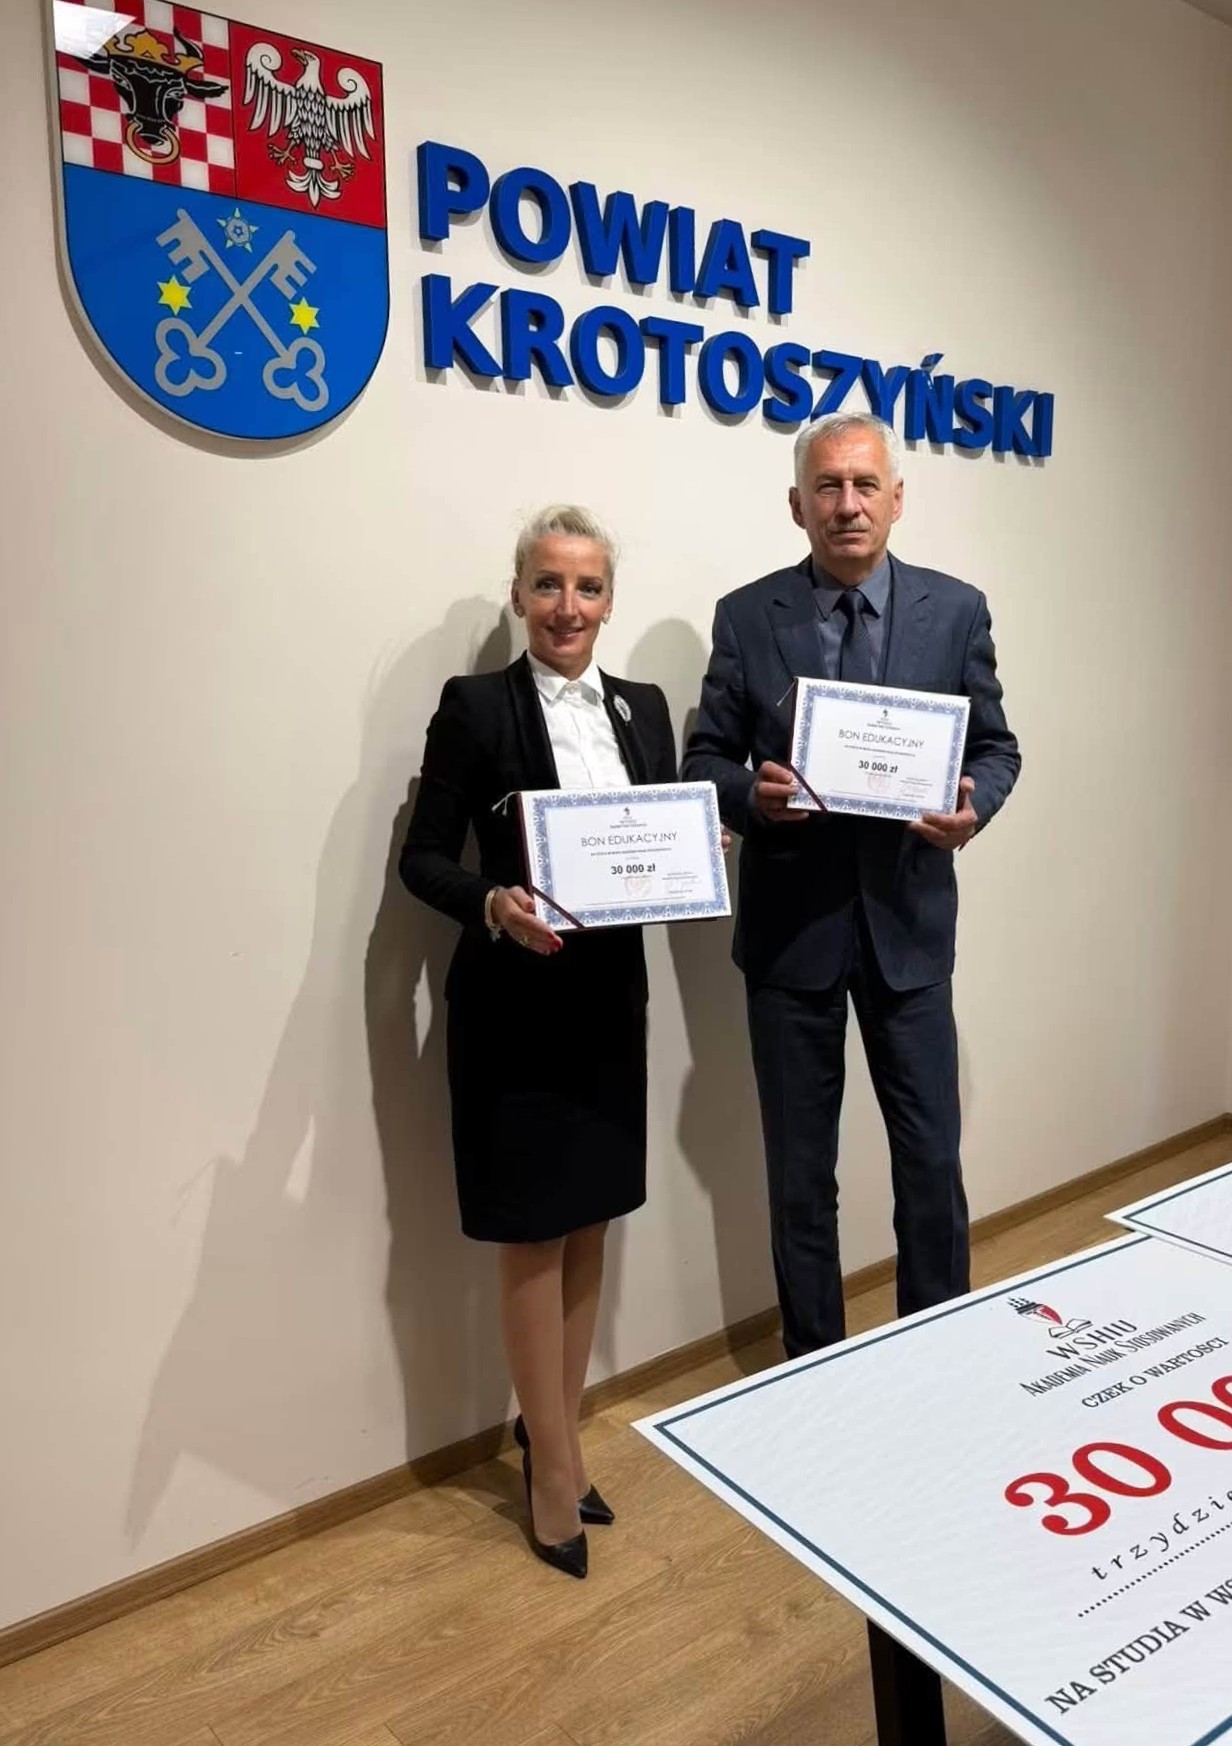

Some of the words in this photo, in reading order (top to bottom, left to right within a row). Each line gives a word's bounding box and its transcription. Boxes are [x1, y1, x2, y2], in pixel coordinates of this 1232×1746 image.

[417, 140, 810, 314] POWIAT
[421, 273, 1054, 457] KROTOSZYŃSKI
[838, 729, 860, 740] BON
[862, 732, 925, 748] EDUKACYJNY
[858, 760, 869, 769] 30
[871, 762, 888, 772] 000
[889, 765, 898, 773] zł
[581, 836, 606, 847] BON
[608, 831, 677, 845] EDUKACYJNY
[611, 866, 623, 875] 30
[626, 864, 644, 873] 000
[647, 863, 656, 872] zł
[1019, 1364, 1092, 1397] AKADEMIA
[1080, 1348, 1127, 1369] NAUK
[1114, 1312, 1207, 1354] STOSOWANYCH
[1046, 1320, 1138, 1360] WSHIU
[1081, 1382, 1134, 1408] CZEK
[1129, 1375, 1148, 1386] O
[1143, 1337, 1230, 1379] WARTOŚCI
[1004, 1442, 1172, 1536] 30
[1157, 1374, 1232, 1450] 0
[1044, 1680, 1098, 1714] NA
[1089, 1619, 1190, 1685] STUDIA
[1179, 1599, 1211, 1623] W
